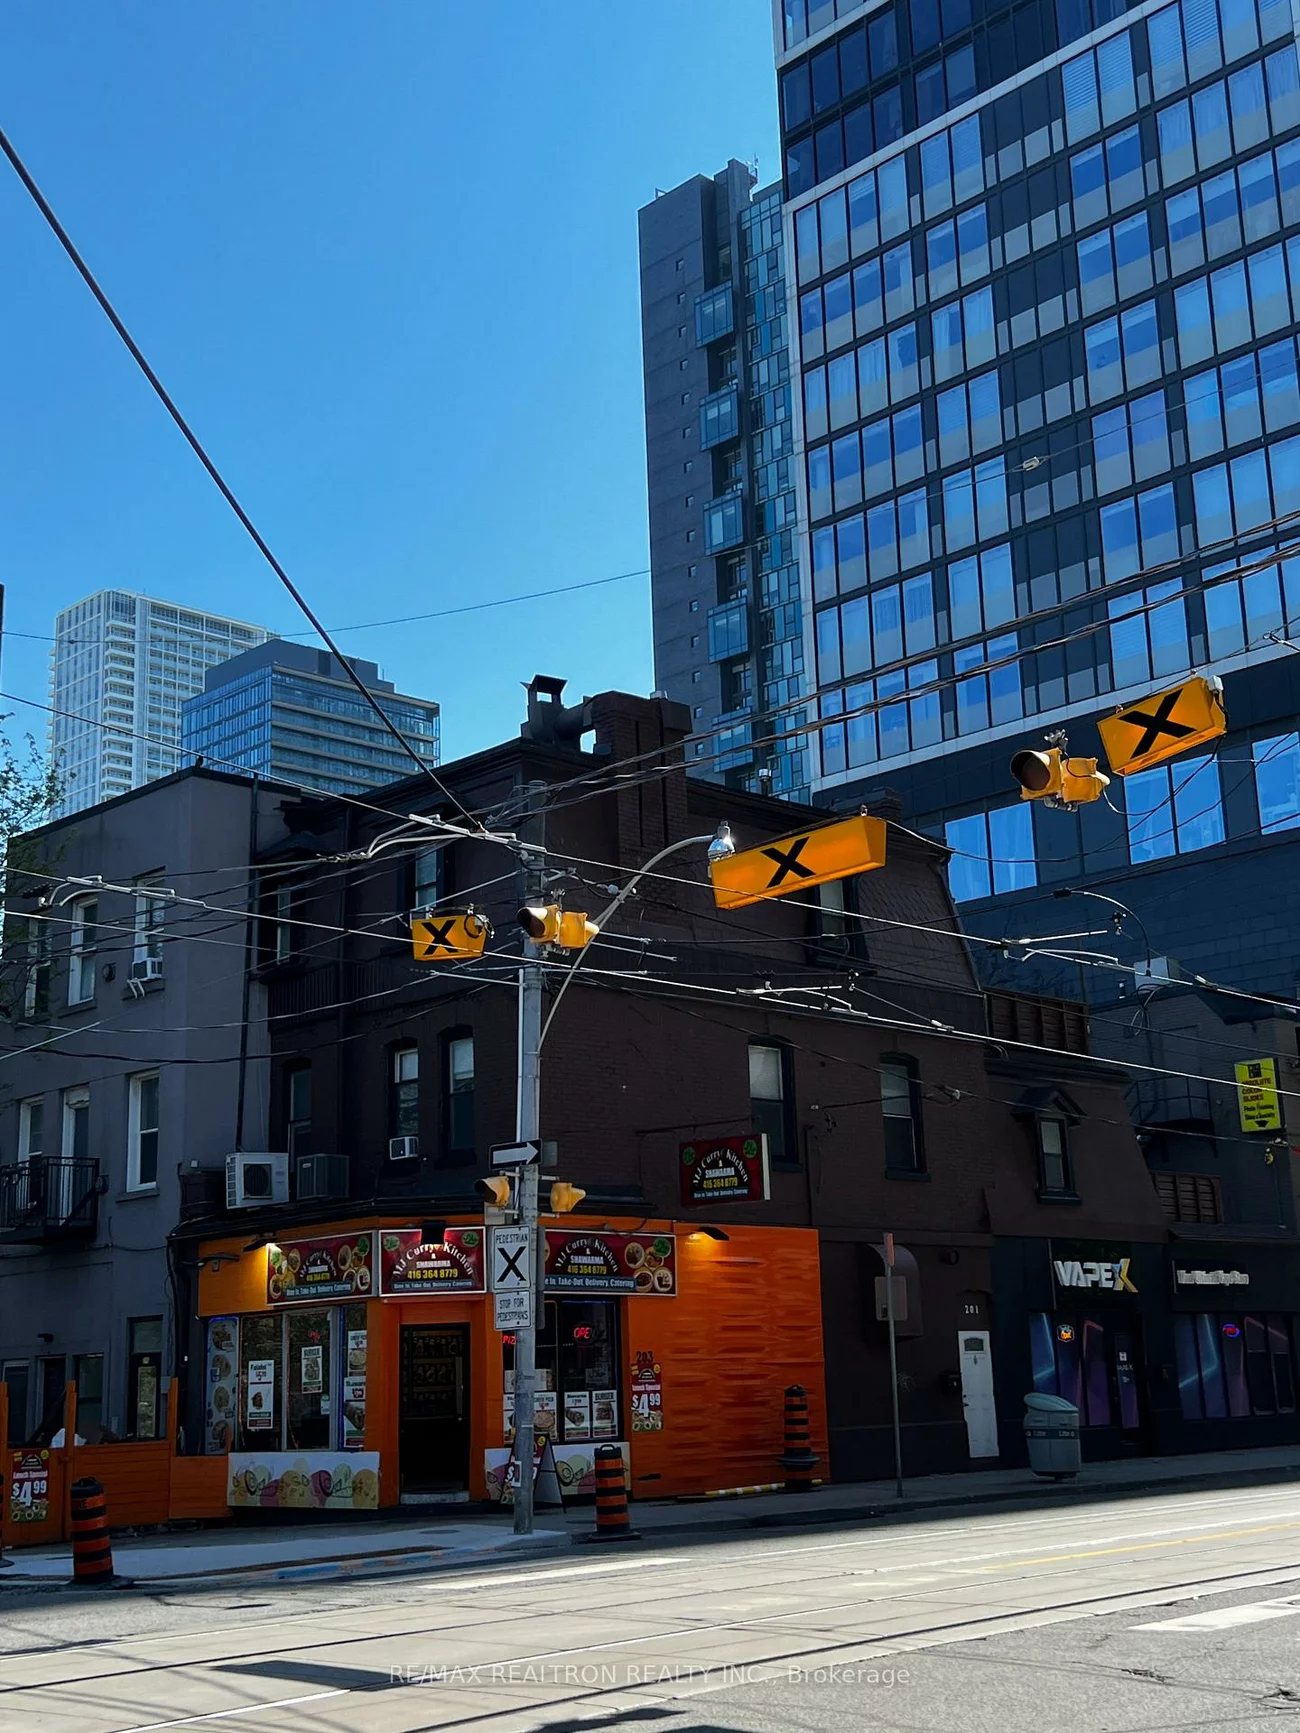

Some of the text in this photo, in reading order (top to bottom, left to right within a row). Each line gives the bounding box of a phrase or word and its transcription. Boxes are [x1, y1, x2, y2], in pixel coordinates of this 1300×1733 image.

[701, 1150, 721, 1168] Curry
[726, 1148, 749, 1182] Kitchen
[495, 1233, 528, 1244] PEDESTRIAN
[406, 1243, 434, 1260] Curry
[443, 1242, 474, 1275] Kitchen
[565, 1238, 587, 1253] Curry
[594, 1238, 619, 1273] Kitchen
[570, 1255, 604, 1265] SHAWARMA
[407, 1268, 459, 1279] 416 364 8779
[610, 1279, 634, 1288] Catering
[499, 1298, 524, 1309] STOP FOR
[964, 1305, 979, 1314] 201
[636, 1351, 654, 1363] 203
